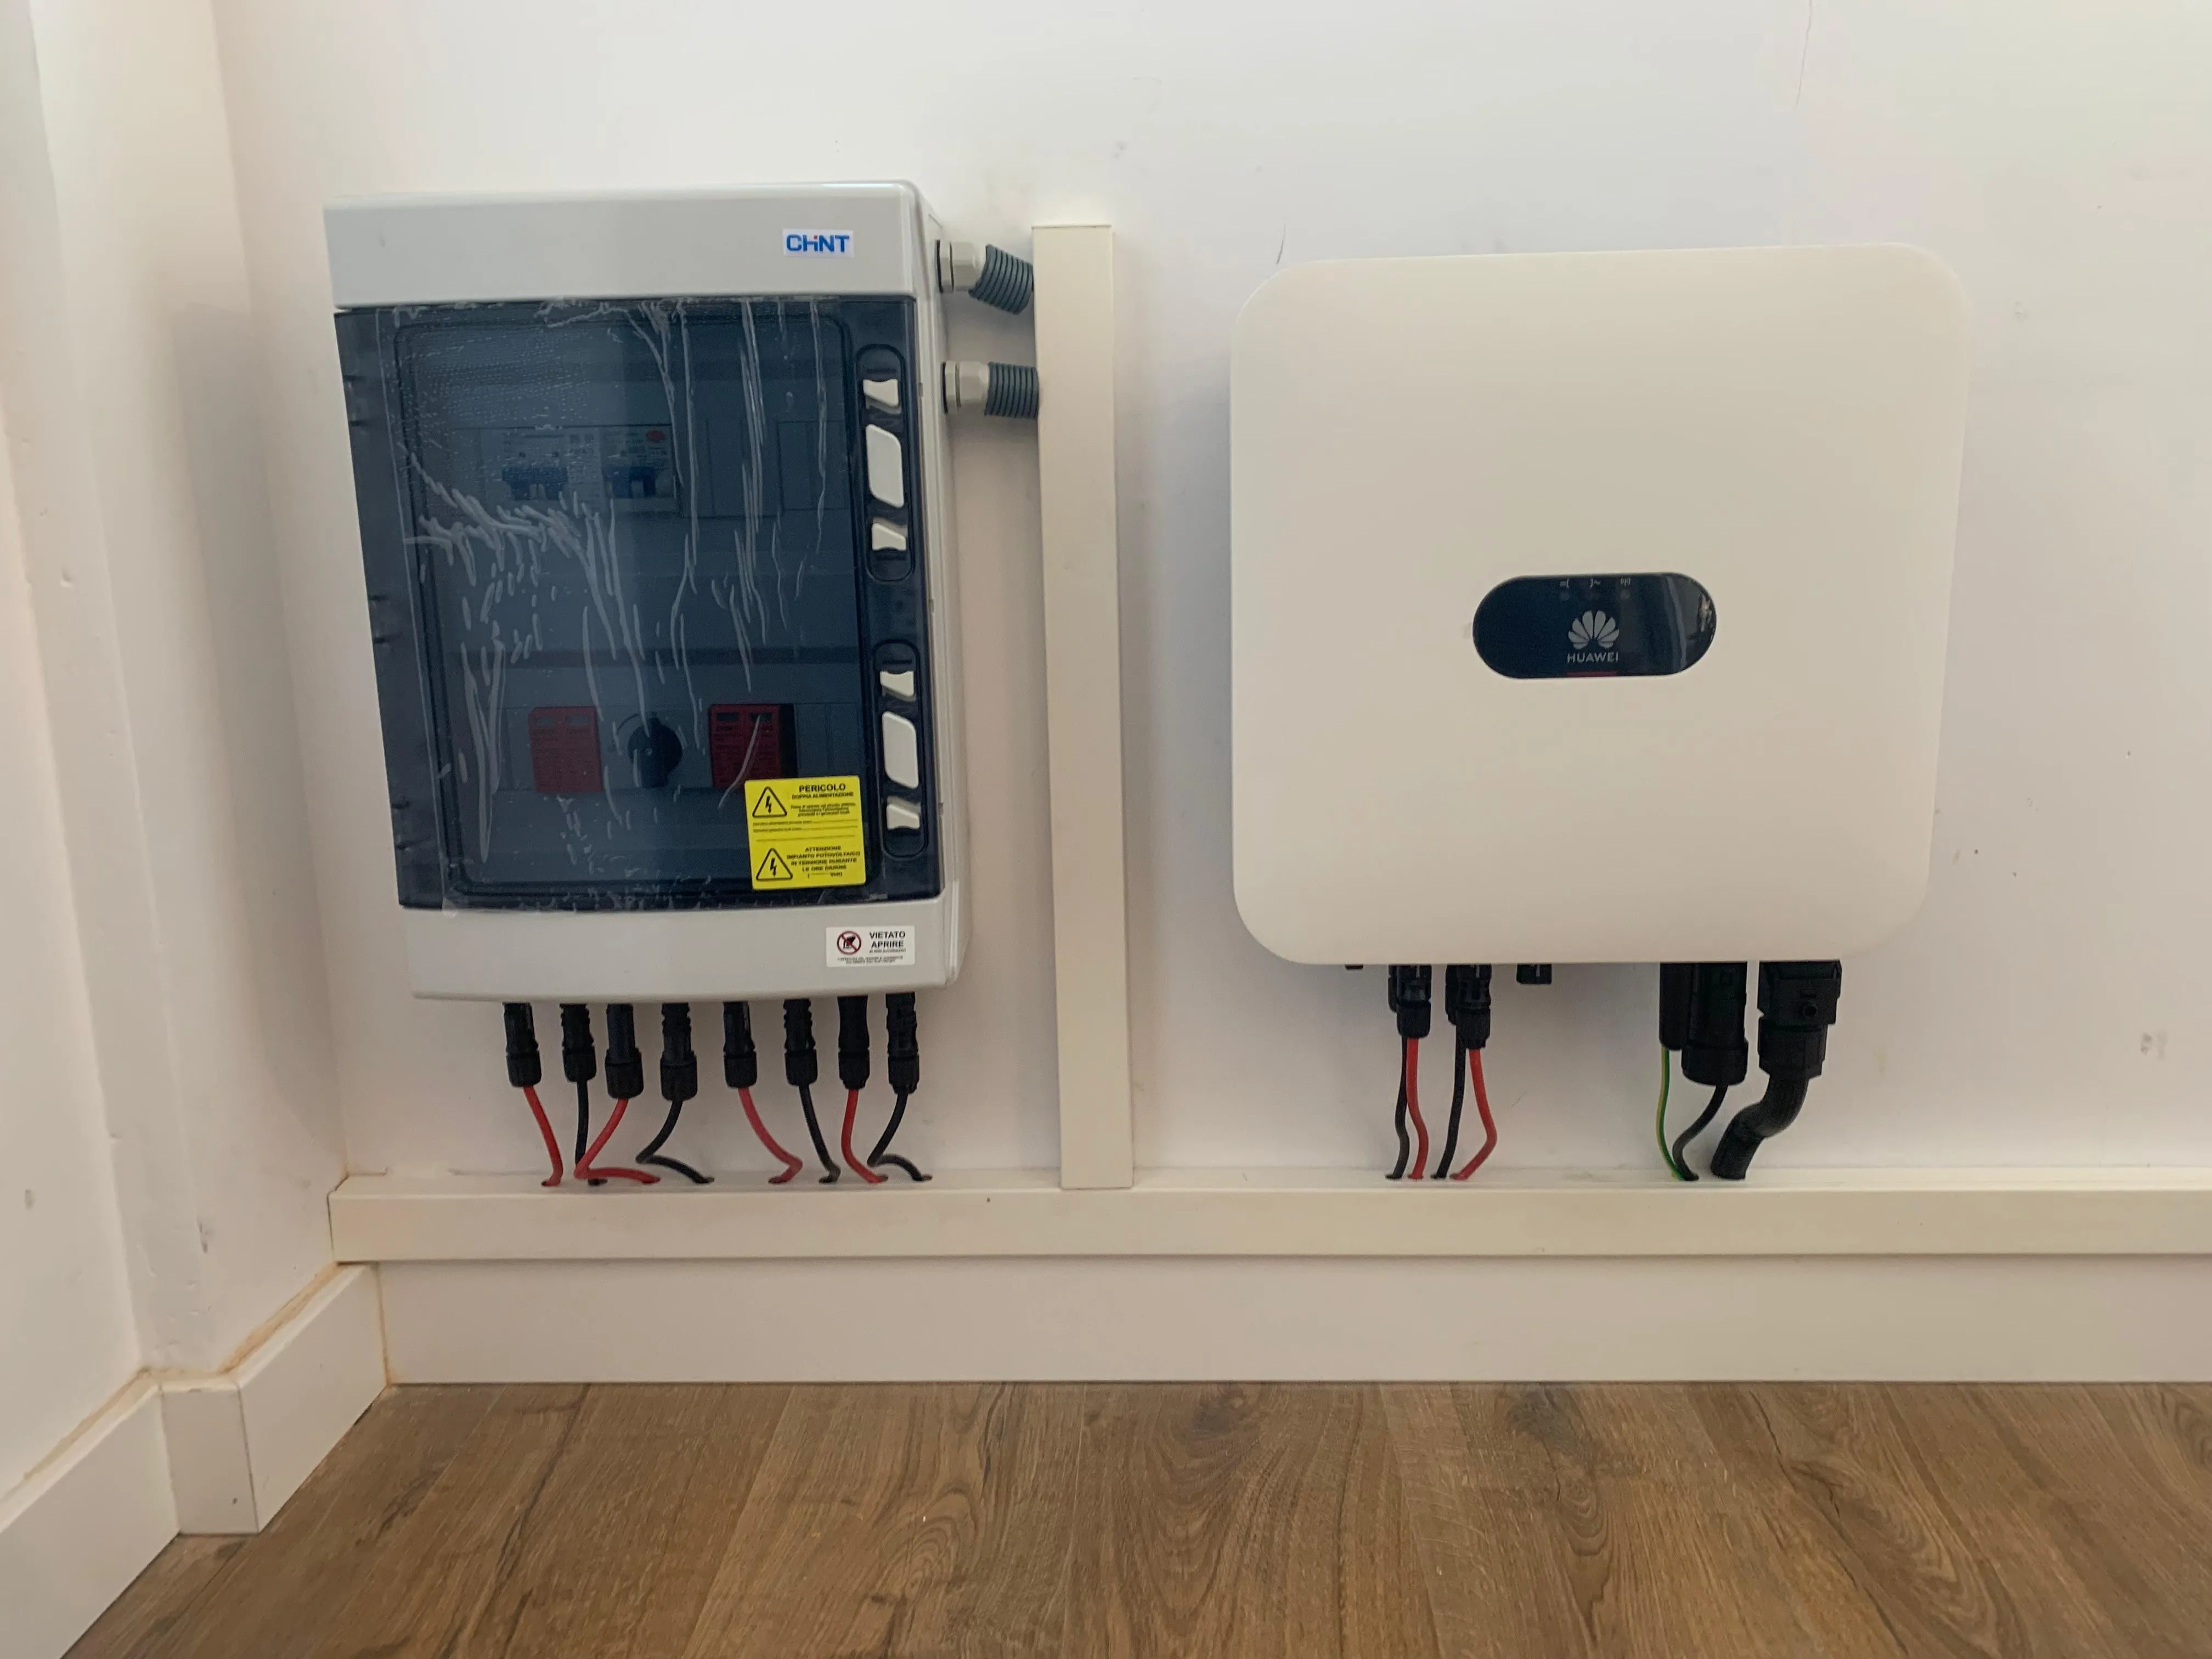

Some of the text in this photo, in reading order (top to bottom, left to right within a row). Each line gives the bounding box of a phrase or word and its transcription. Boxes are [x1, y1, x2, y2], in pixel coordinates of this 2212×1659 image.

[1567, 651, 1618, 664] HUAWEI
[799, 783, 846, 793] PERICOLO
[869, 930, 906, 940] VIETATO
[871, 940, 904, 949] APRIRE
